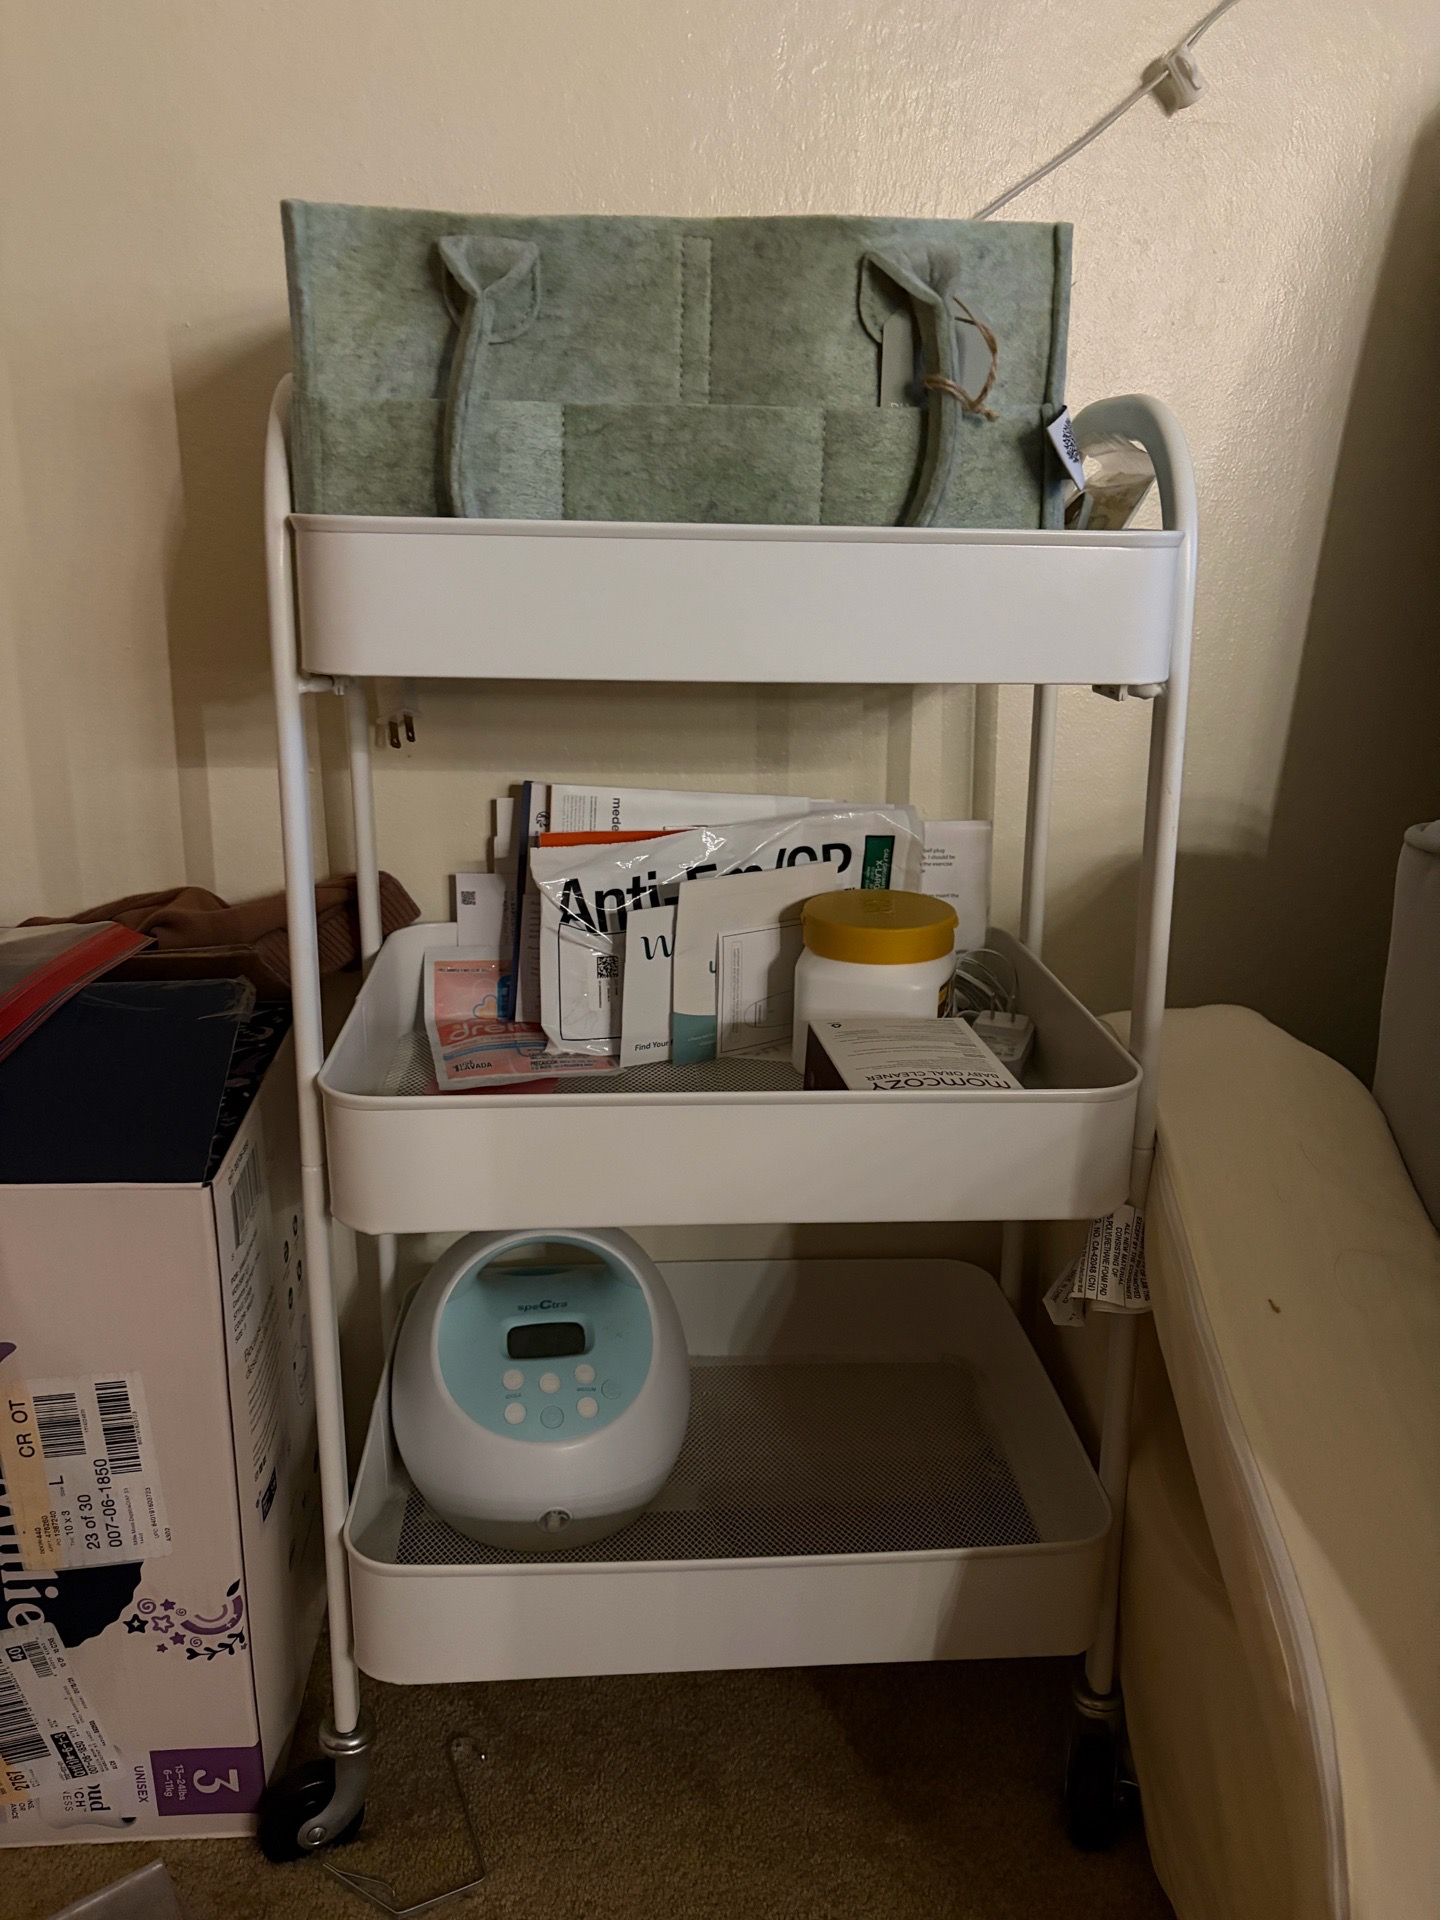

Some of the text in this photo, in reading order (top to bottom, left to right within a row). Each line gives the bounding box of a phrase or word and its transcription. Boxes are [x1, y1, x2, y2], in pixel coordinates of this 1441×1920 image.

[634, 1043, 651, 1051] Find
[865, 1071, 926, 1081] CLEANER
[967, 1071, 1000, 1079] BABY
[8, 1400, 35, 1458] CR OT
[49, 1475, 64, 1486] L
[93, 1459, 123, 1548] 007-06-1850
[64, 1525, 73, 1536] 10
[77, 1494, 101, 1550] 23 of 30
[8, 1647, 24, 1660] 40
[6, 1770, 30, 1791] 2767
[134, 1765, 149, 1803] UNISEX
[193, 1769, 240, 1794] 3
